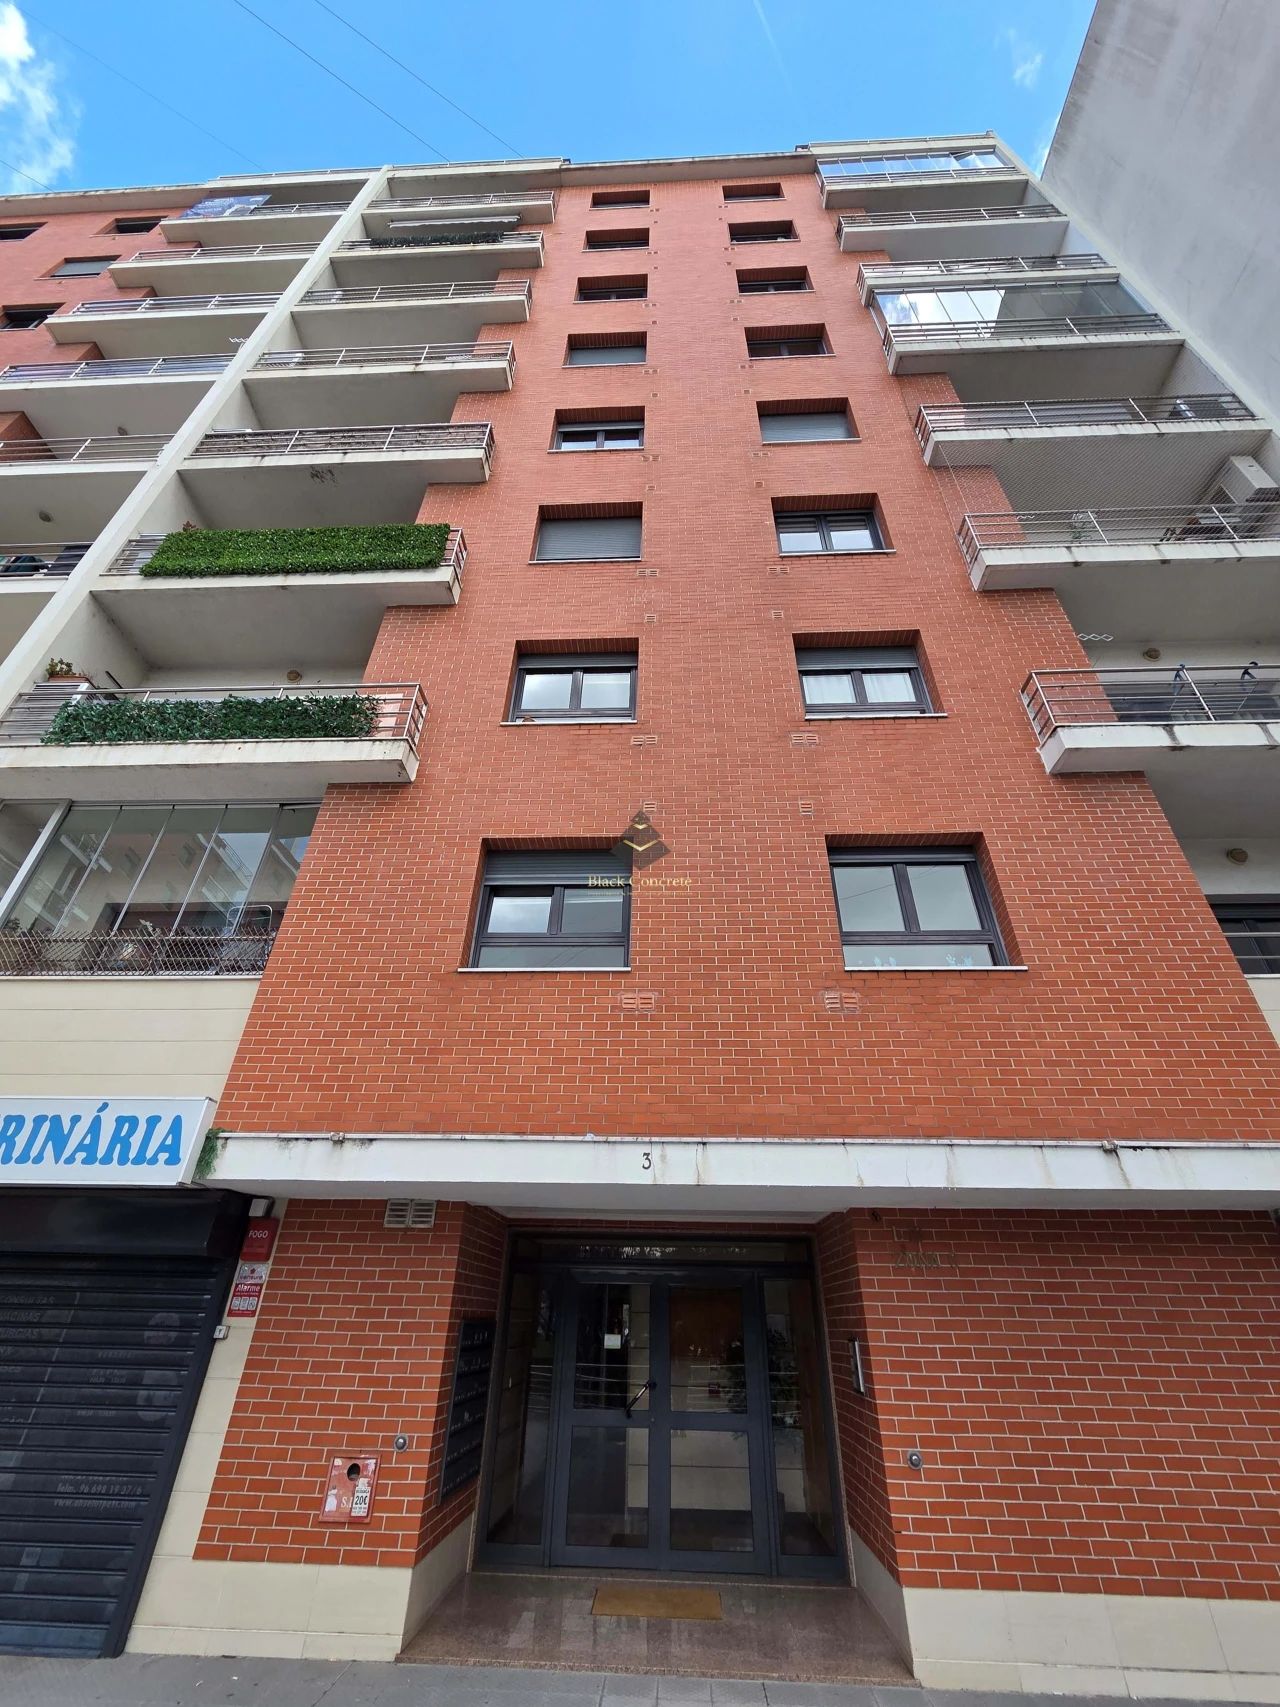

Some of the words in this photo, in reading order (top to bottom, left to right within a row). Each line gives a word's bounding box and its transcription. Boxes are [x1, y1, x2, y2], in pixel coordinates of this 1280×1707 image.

[641, 1152, 651, 1170] 3
[248, 1230, 269, 1238] FOGO
[235, 1284, 260, 1292] Alarme
[355, 1495, 368, 1506] 20€
